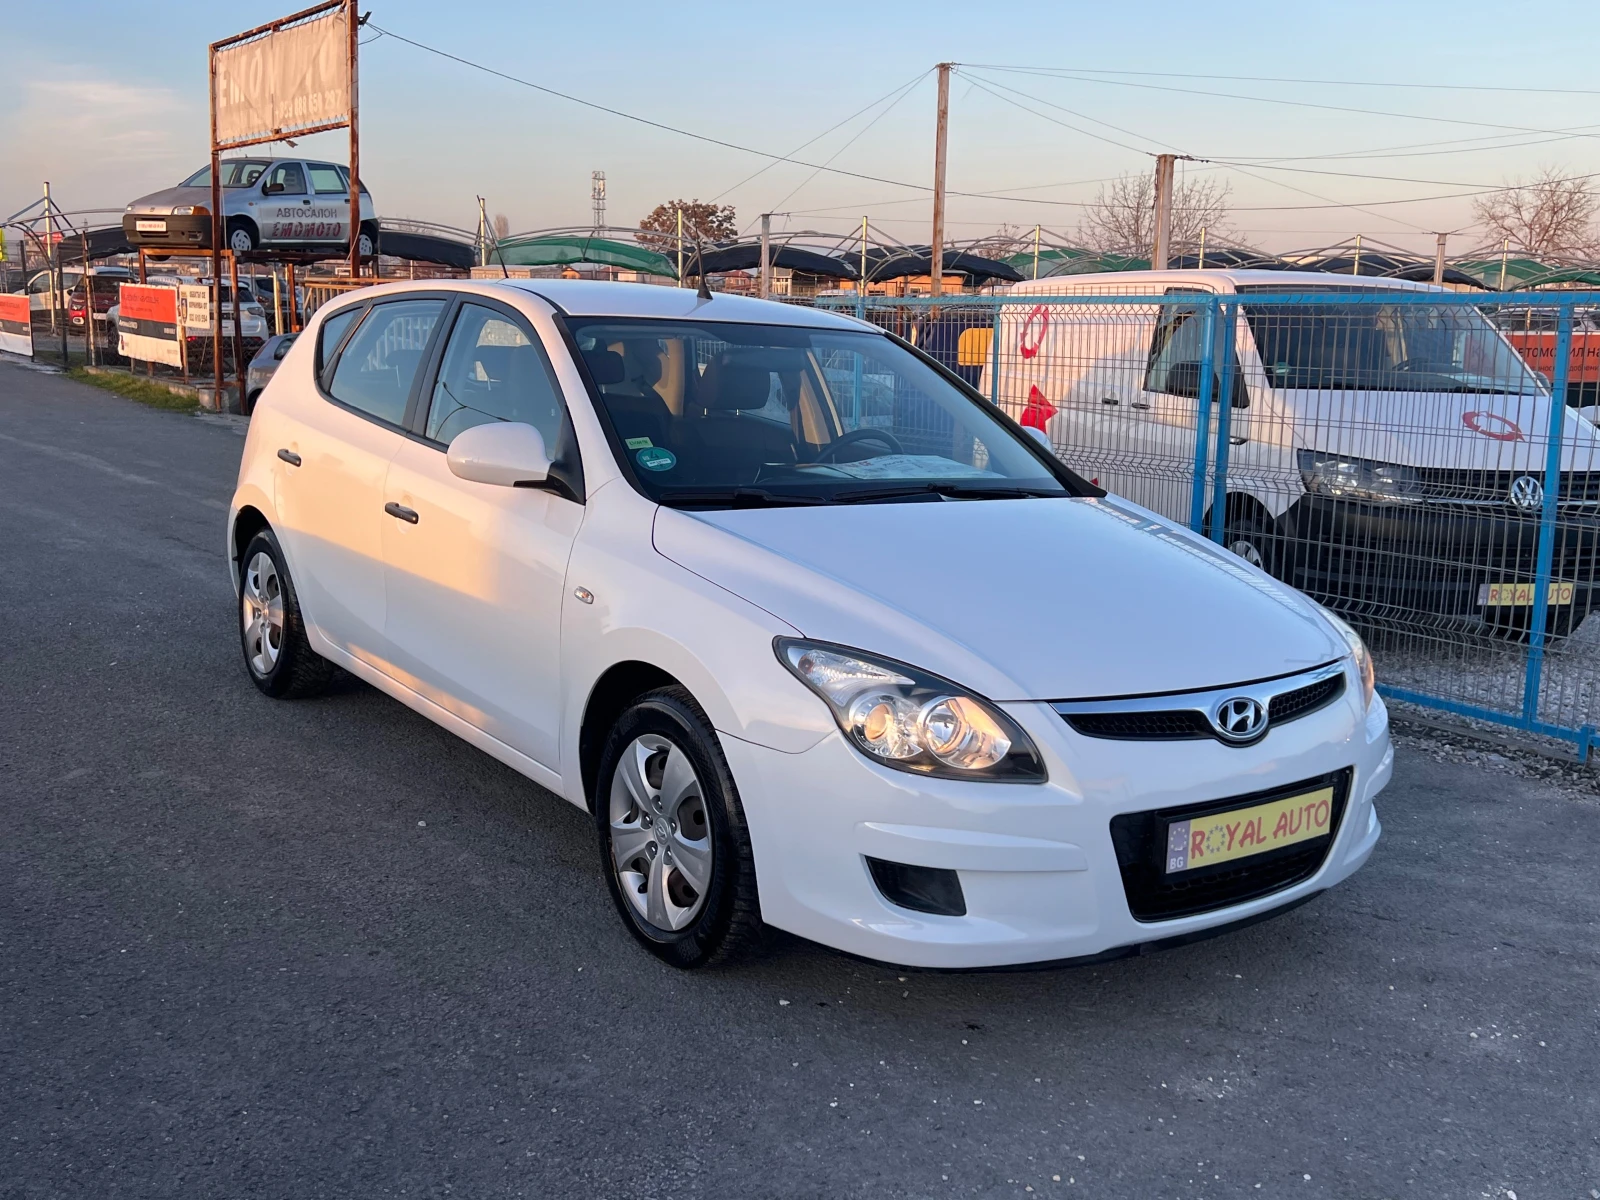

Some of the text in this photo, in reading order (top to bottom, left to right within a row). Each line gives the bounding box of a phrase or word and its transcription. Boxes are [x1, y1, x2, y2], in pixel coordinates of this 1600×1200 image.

[276, 207, 338, 218] АВТОСАЛОН
[1191, 799, 1329, 859] ROYAL AUTO
[1169, 856, 1184, 870] BG
